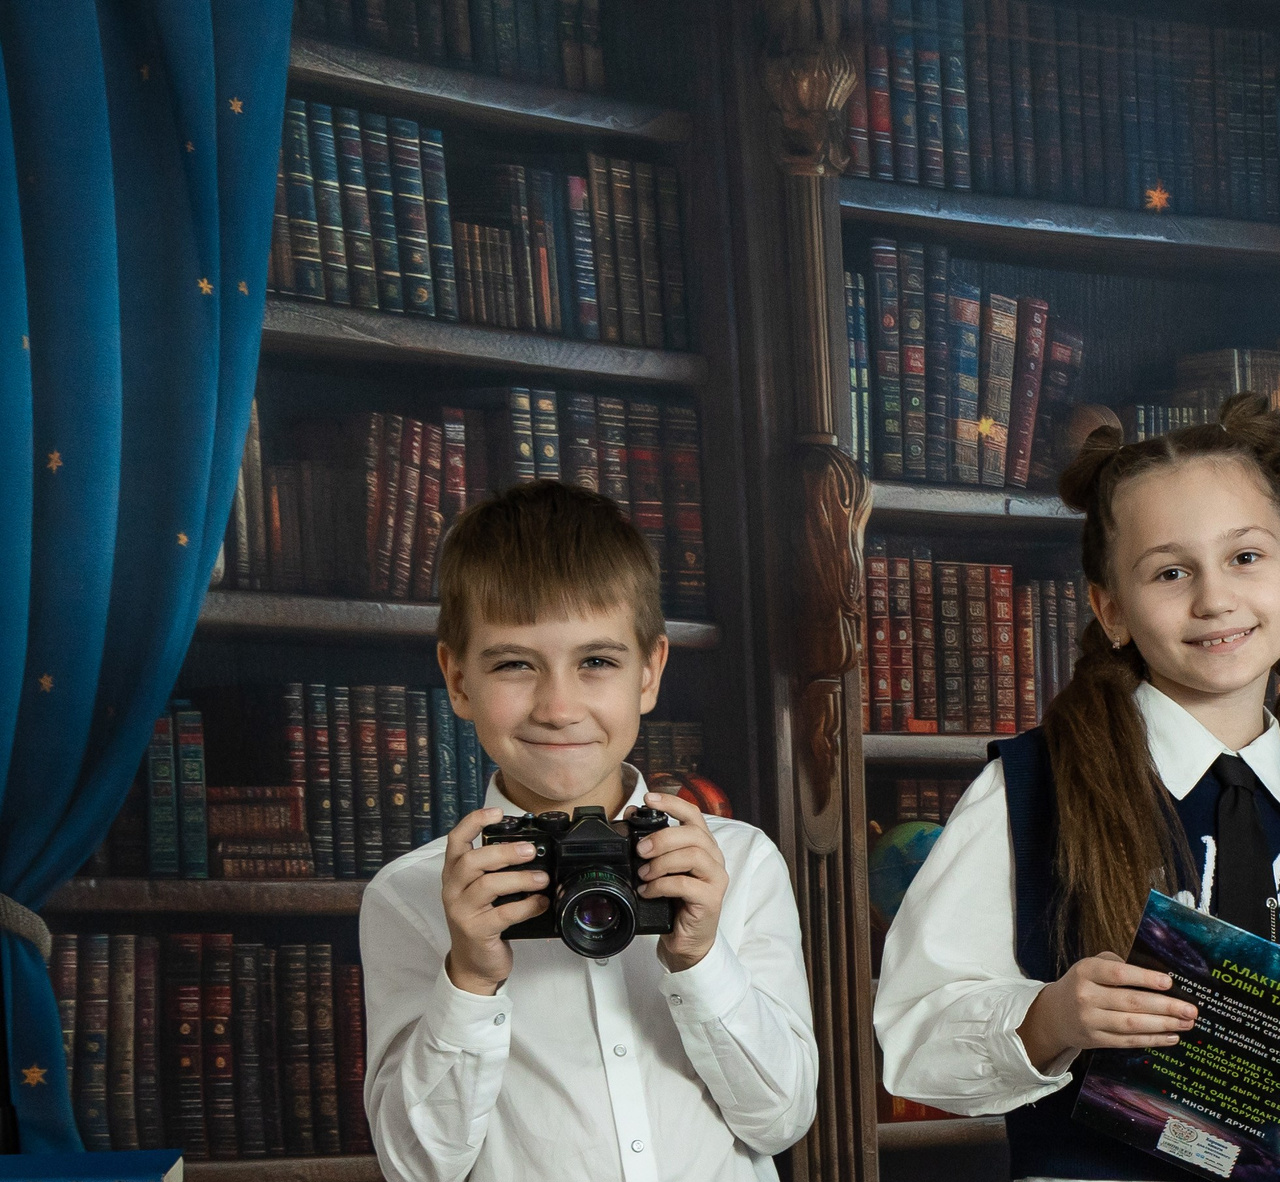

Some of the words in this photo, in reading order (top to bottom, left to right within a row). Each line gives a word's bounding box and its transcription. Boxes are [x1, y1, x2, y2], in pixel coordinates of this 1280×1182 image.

[1168, 971, 1212, 994] ОТПРАВЬСЯ
[1211, 968, 1265, 998] ПОЛНЫ
[1180, 985, 1193, 994] ПО
[1195, 991, 1260, 1023] КОСМИЧЕСКОМУ
[1206, 1004, 1243, 1024] РАСКРОЙ
[1245, 1021, 1261, 1031] ЭТИ
[1214, 1023, 1226, 1032] ТЫ
[1228, 1029, 1266, 1050] НАЙДЁШЬ
[1214, 1031, 1269, 1059] НЕВЕРОЯТНЫЕ
[1145, 1047, 1186, 1068] ПОЧЕМУ
[1189, 1065, 1227, 1087] ЧЁРНЫЕ
[1230, 1085, 1261, 1101] ДЫРЫ
[1185, 1050, 1240, 1078] МЛЕЧНОГО
[1243, 1076, 1275, 1094] ПУТИ?
[1206, 1043, 1226, 1057] КАК
[1230, 1054, 1274, 1077] УВИДЕТЬ
[1152, 1063, 1188, 1083] МОЖЕТ
[1191, 1081, 1206, 1091] ЛИ
[1209, 1089, 1238, 1105] ОДНА
[1170, 1080, 1216, 1103] «СЪЕСТЬ»
[1220, 1101, 1266, 1125] ВТОРУЮ?
[1170, 1092, 1178, 1100] И
[1181, 1097, 1222, 1120] МНОГИЕ
[1224, 1117, 1266, 1139] ДРУГИЕ!
